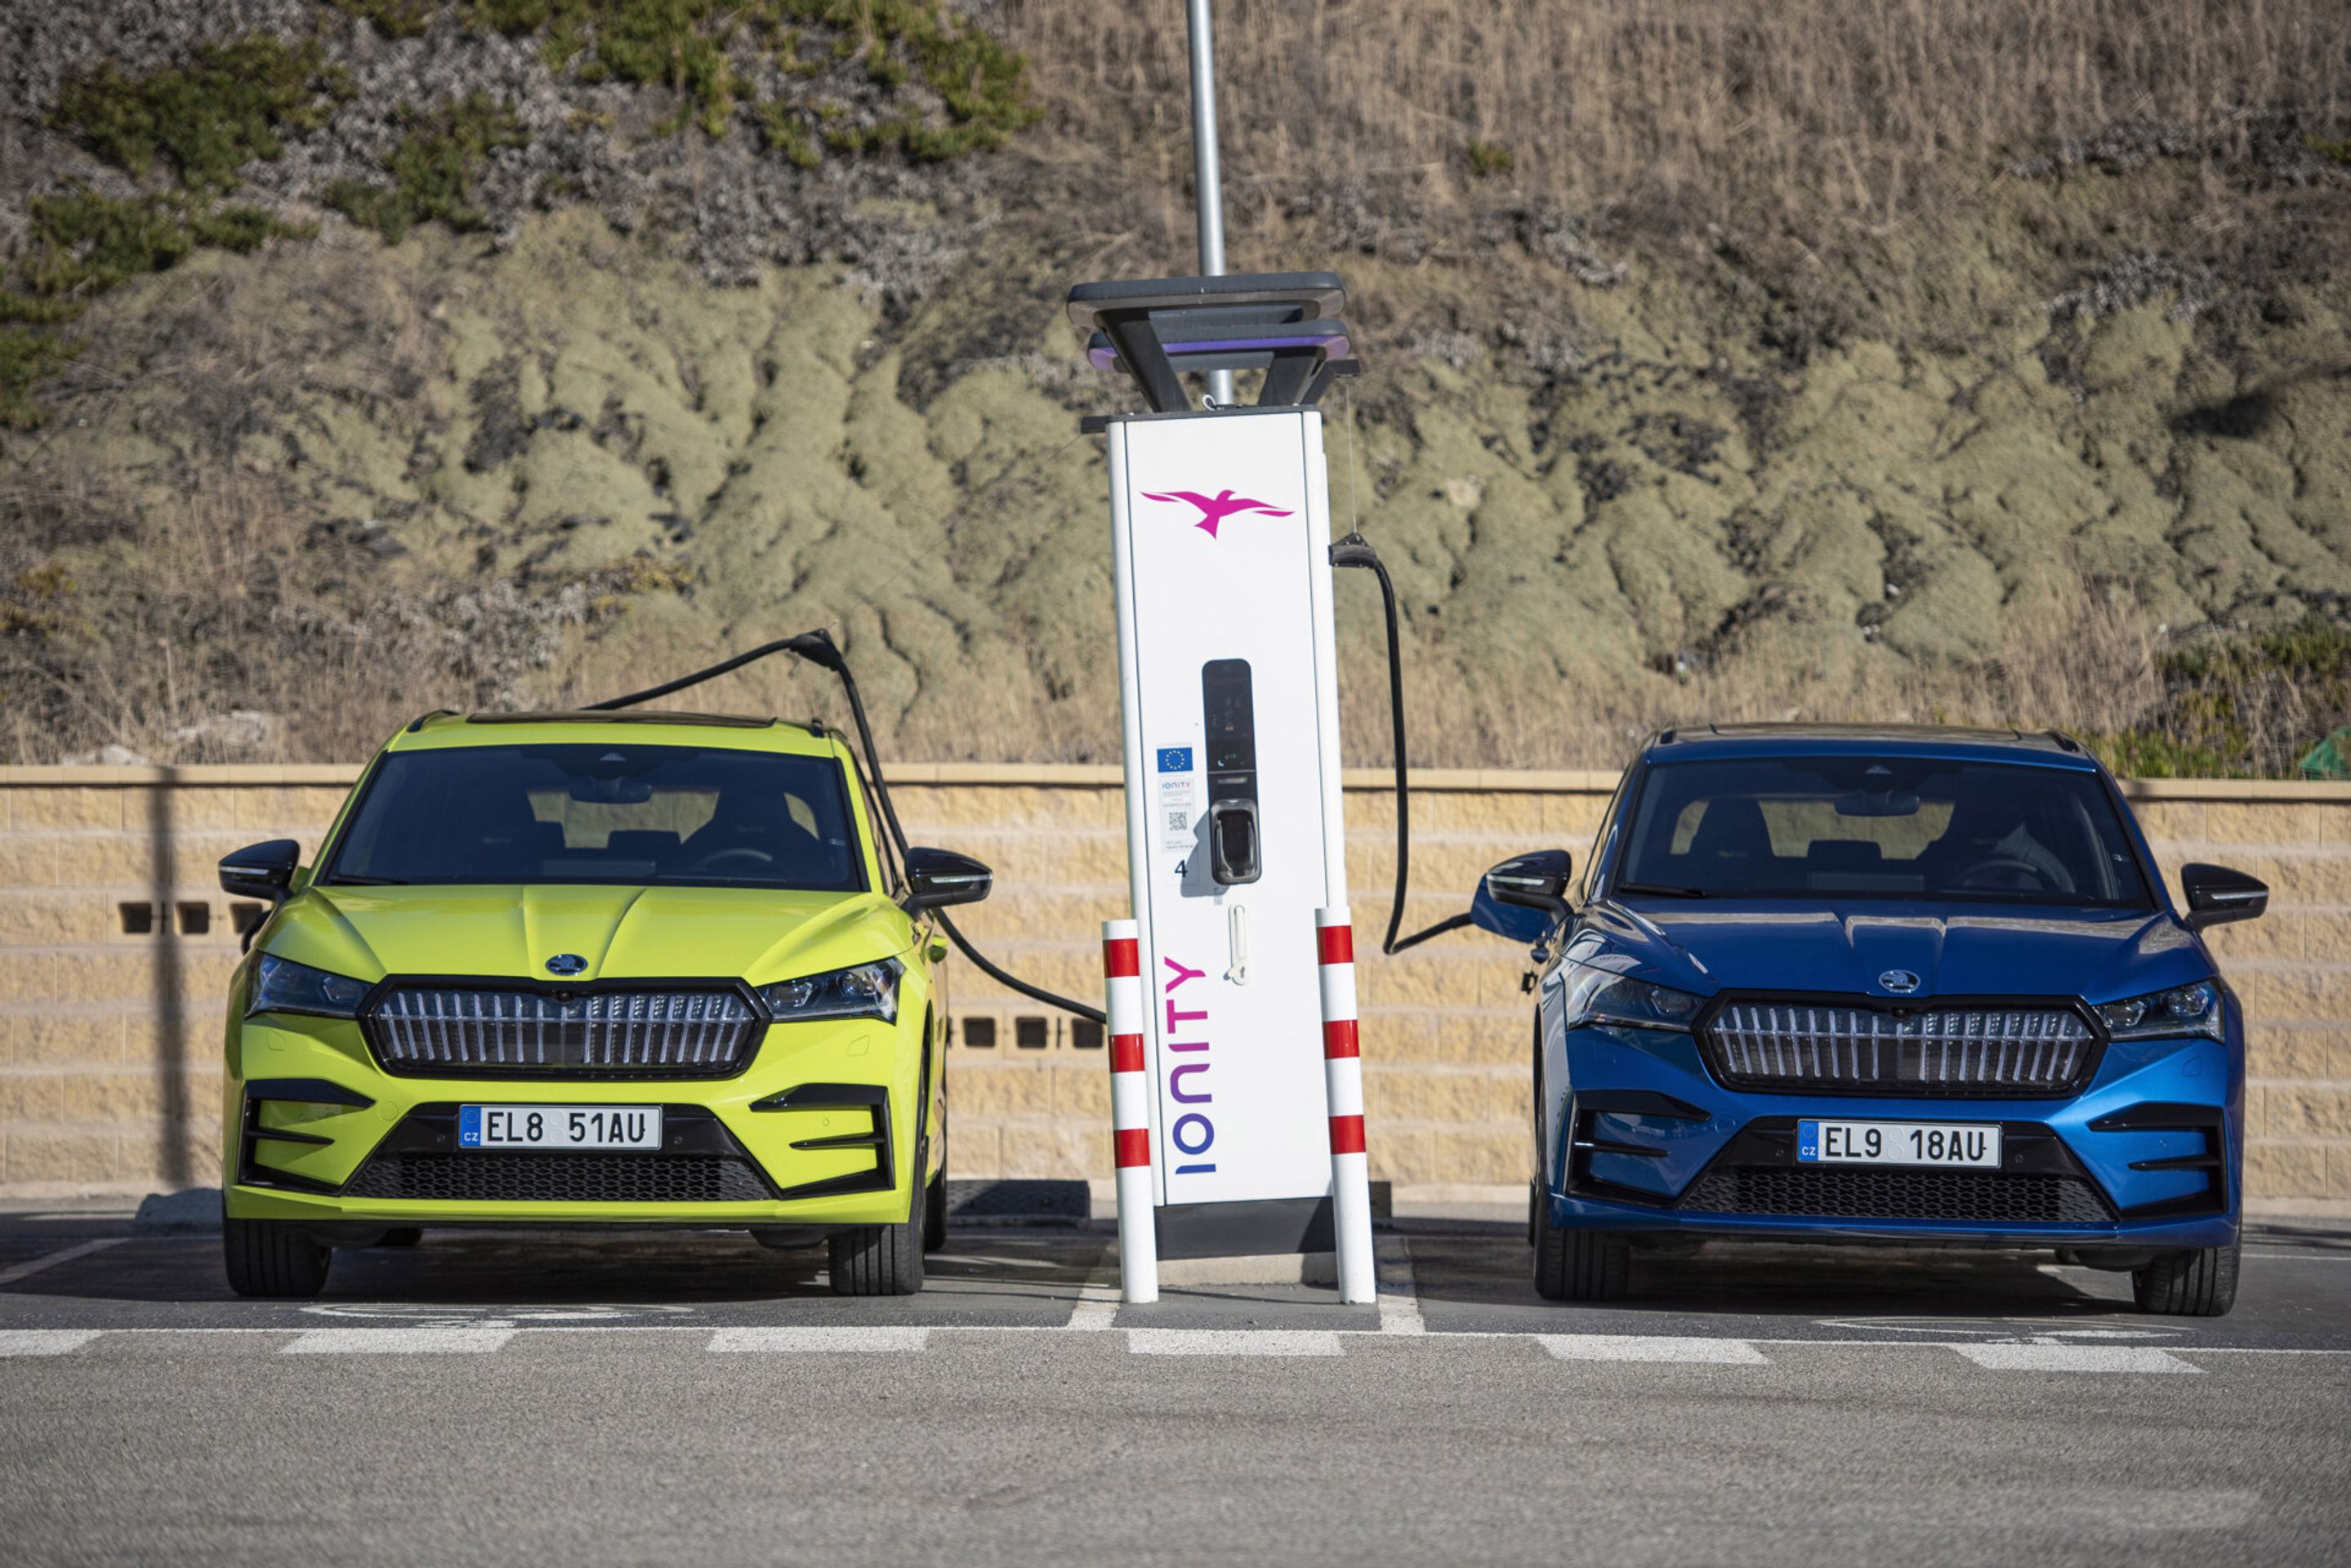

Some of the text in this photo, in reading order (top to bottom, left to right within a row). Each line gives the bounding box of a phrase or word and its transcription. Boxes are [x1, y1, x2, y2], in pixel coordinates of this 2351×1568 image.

[1175, 860, 1188, 877] 4
[1164, 956, 1216, 1174] IONITY
[463, 1132, 480, 1143] CZ
[487, 1111, 645, 1143] EL8 51AU
[1801, 1146, 1816, 1156] CZ
[1825, 1127, 1984, 1161] EL9 18AU
